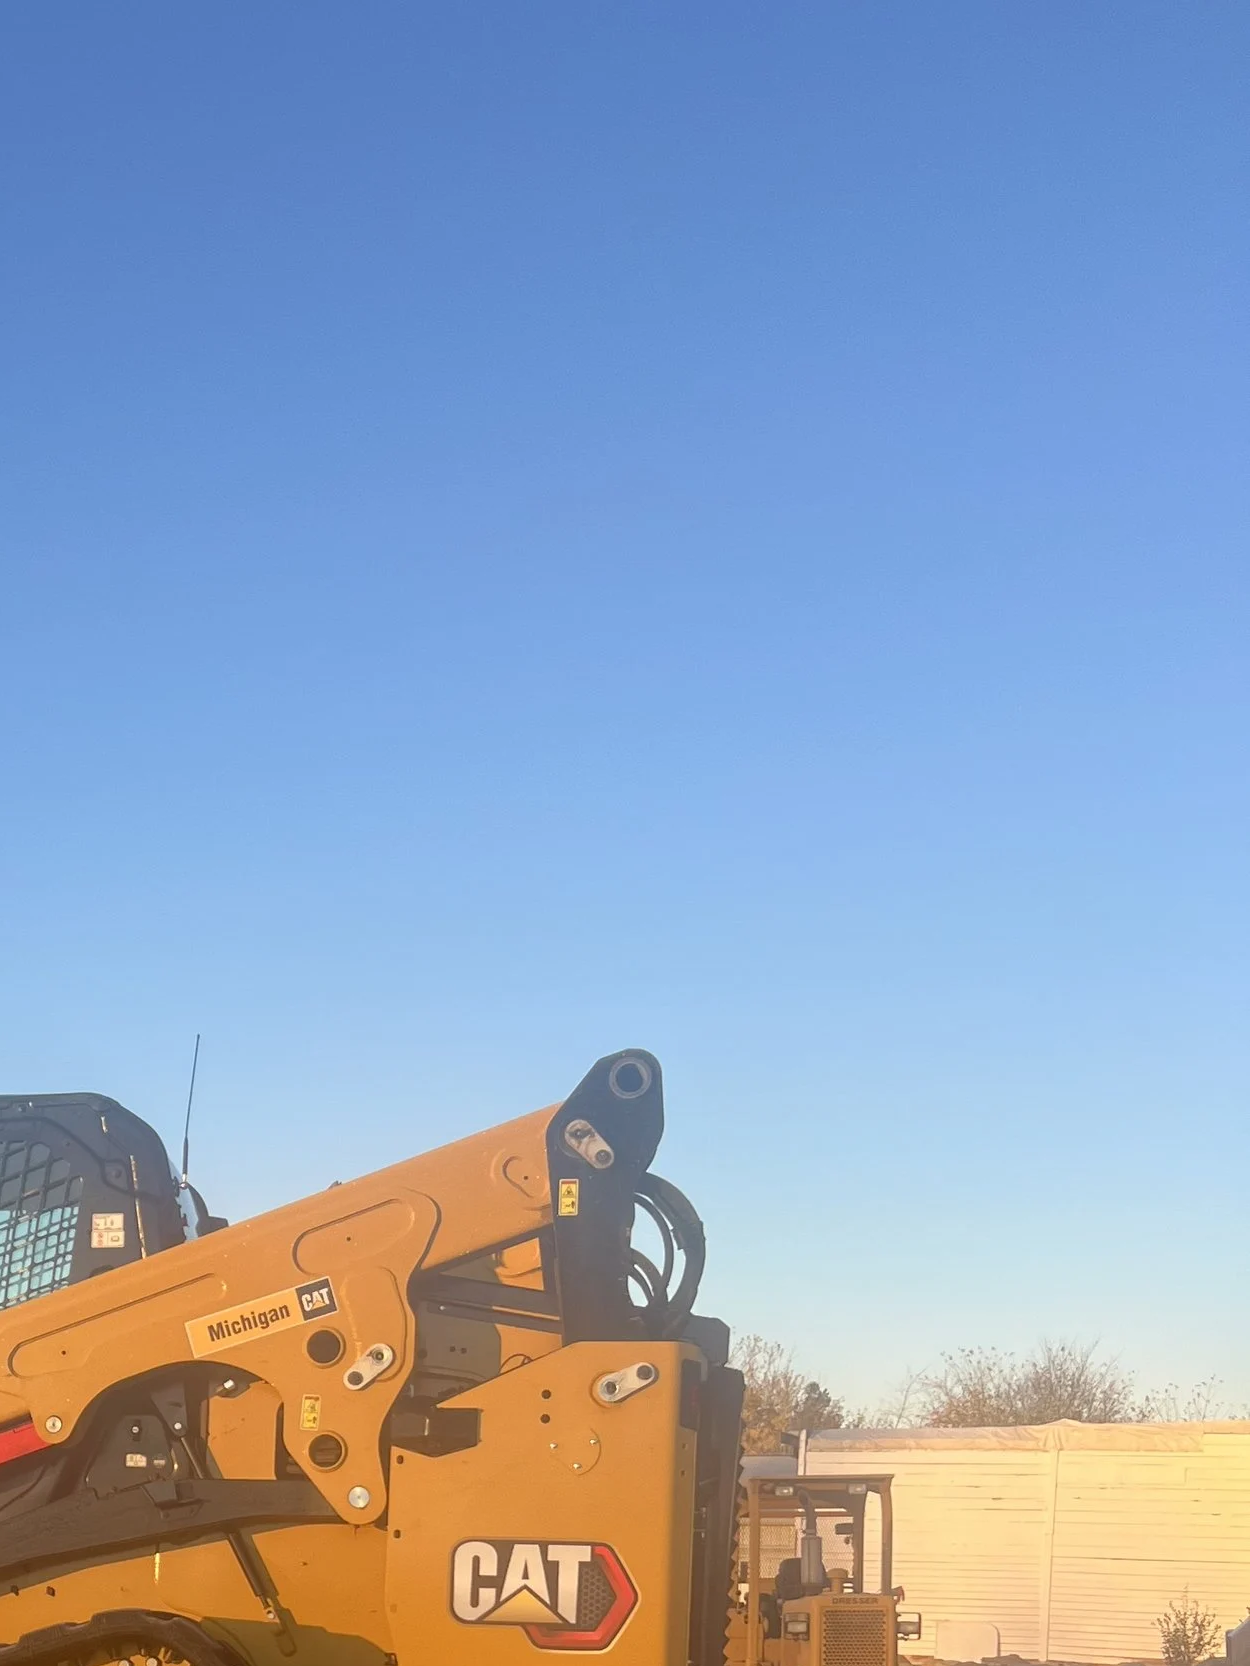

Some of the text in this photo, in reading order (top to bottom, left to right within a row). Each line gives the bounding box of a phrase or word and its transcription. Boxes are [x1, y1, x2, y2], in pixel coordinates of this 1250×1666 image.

[207, 1287, 331, 1342] Michigan CAT
[452, 1541, 592, 1625] CAT
[832, 1597, 879, 1605] DRESSER
